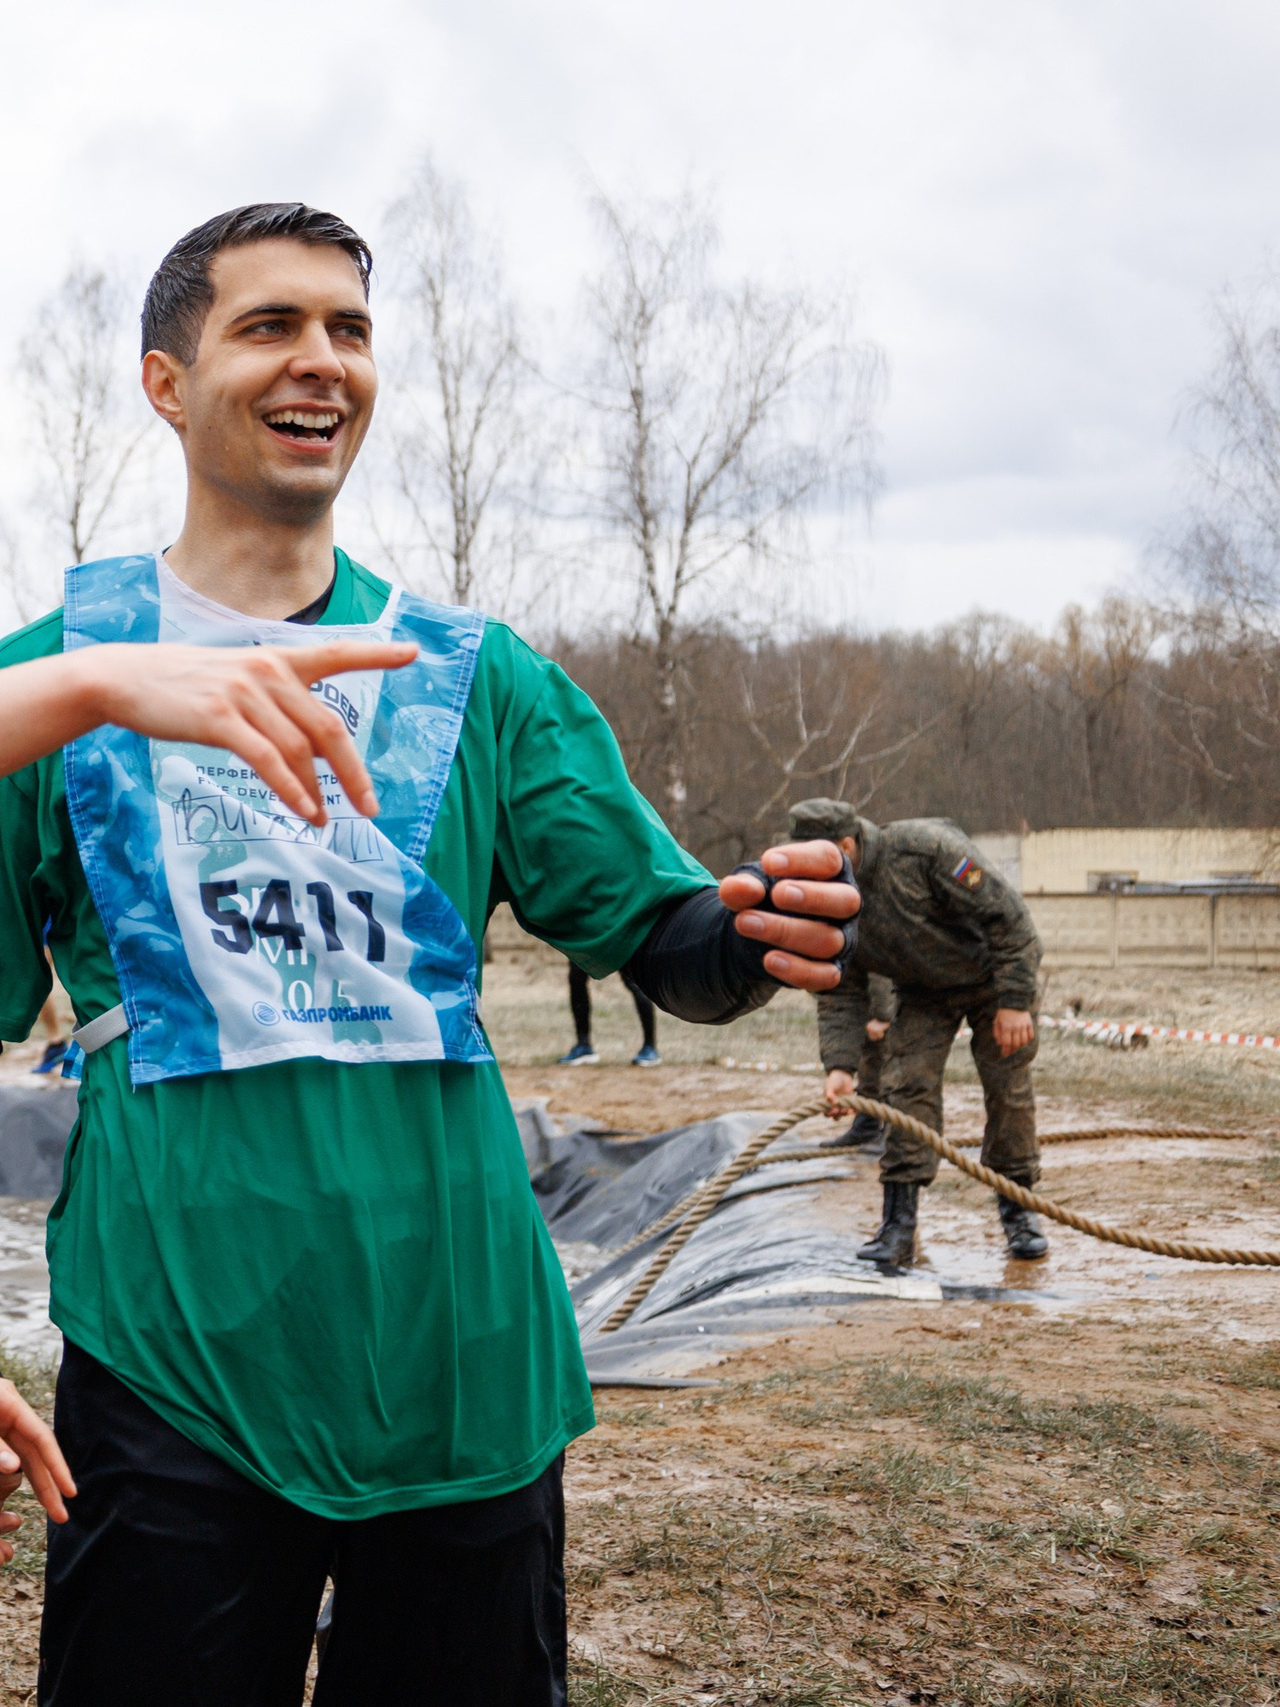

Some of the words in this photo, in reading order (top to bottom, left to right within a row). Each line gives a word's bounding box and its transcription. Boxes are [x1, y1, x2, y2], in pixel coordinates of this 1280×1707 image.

[310, 680, 360, 729] РОЕВ
[199, 878, 386, 963] 5411
[281, 1005, 393, 1024] ГАЗПРОМБАНК
